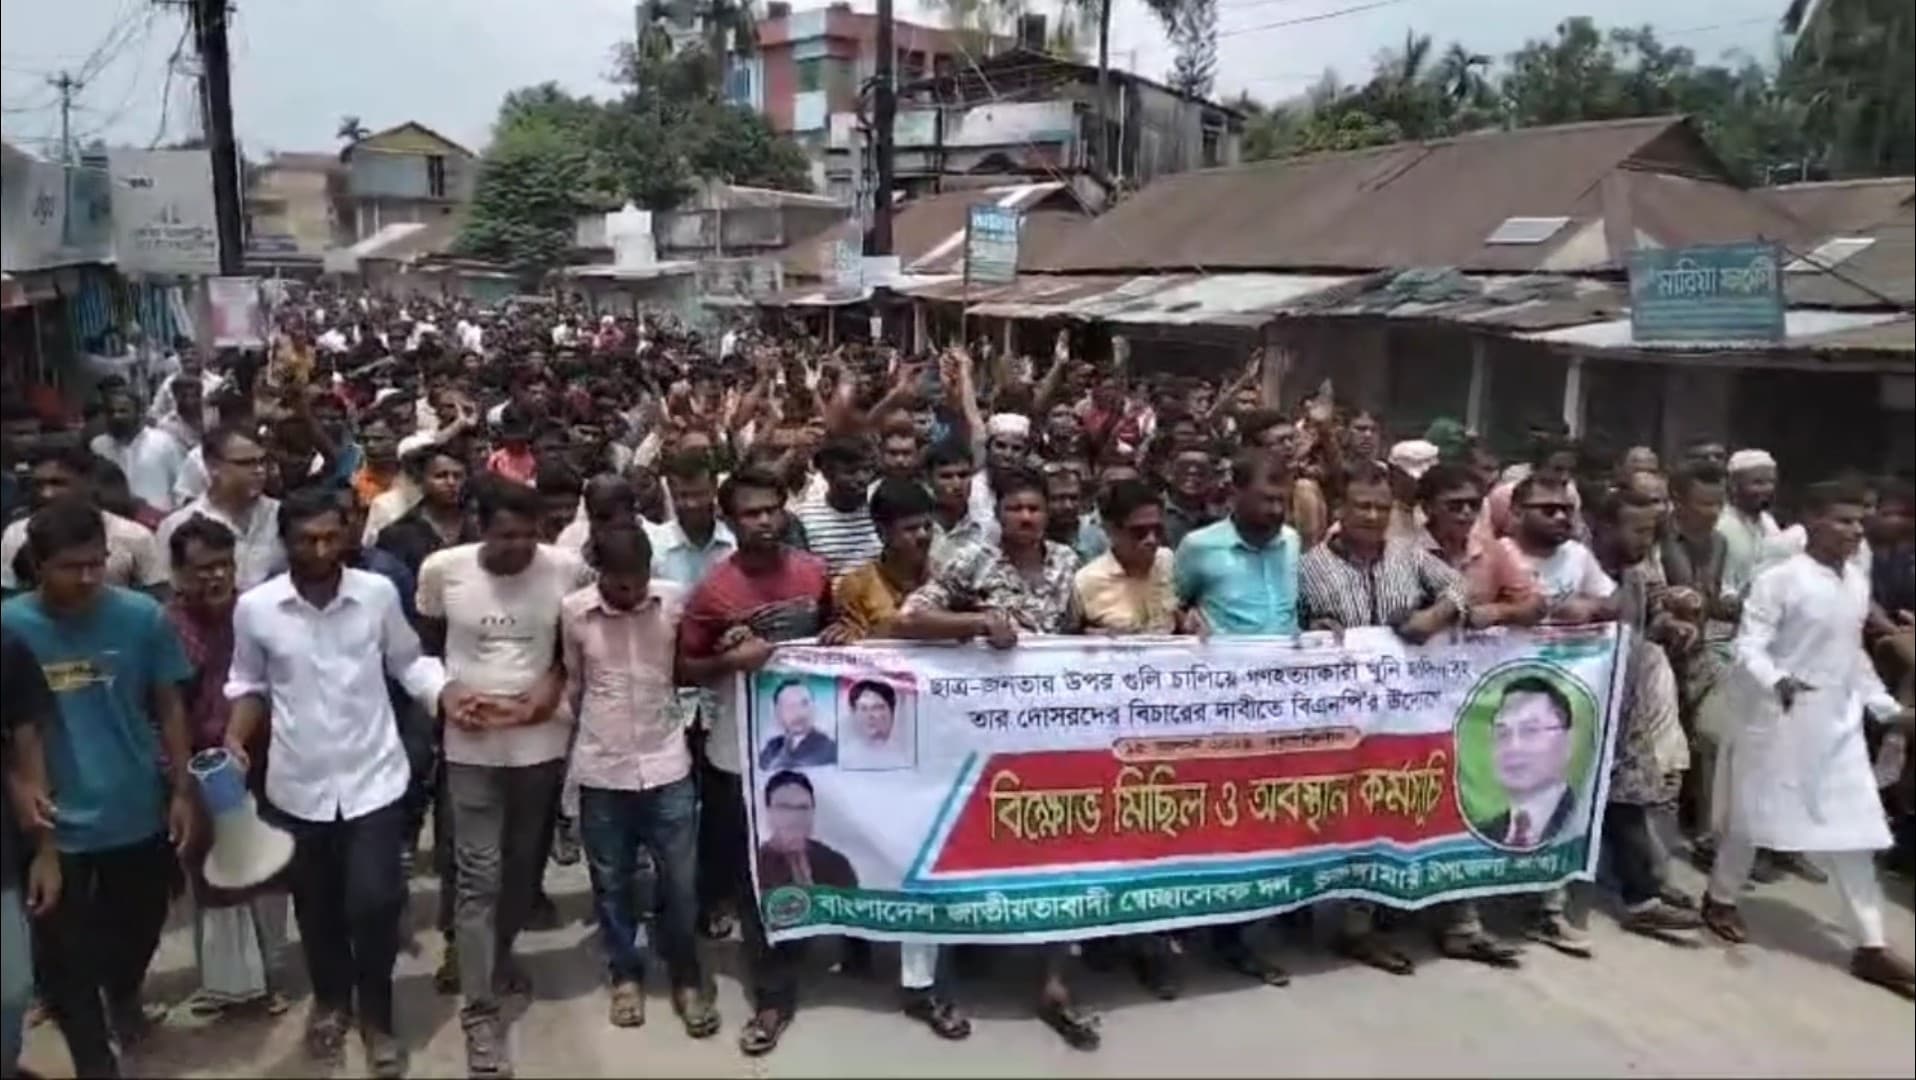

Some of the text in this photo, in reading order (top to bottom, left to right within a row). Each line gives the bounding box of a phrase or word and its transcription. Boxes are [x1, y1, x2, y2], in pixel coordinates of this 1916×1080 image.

[930, 674, 1054, 700] ছাত্র-জনতার
[1064, 667, 1114, 693] উপর
[1122, 664, 1161, 693] গুলি
[1170, 663, 1237, 690] চালিয়ে
[1246, 660, 1358, 687] গণহত্যাকারী
[967, 708, 1009, 731] তার
[1017, 705, 1119, 729] দোসরদের
[1127, 697, 1206, 726] বিচারের
[989, 749, 1447, 840] বিক্ষোভ মিছিল ও অবস্থান কর্মসূচি
[813, 893, 935, 923] বাংলাদেশ
[946, 886, 1112, 924] জাতীয়তাবাদী
